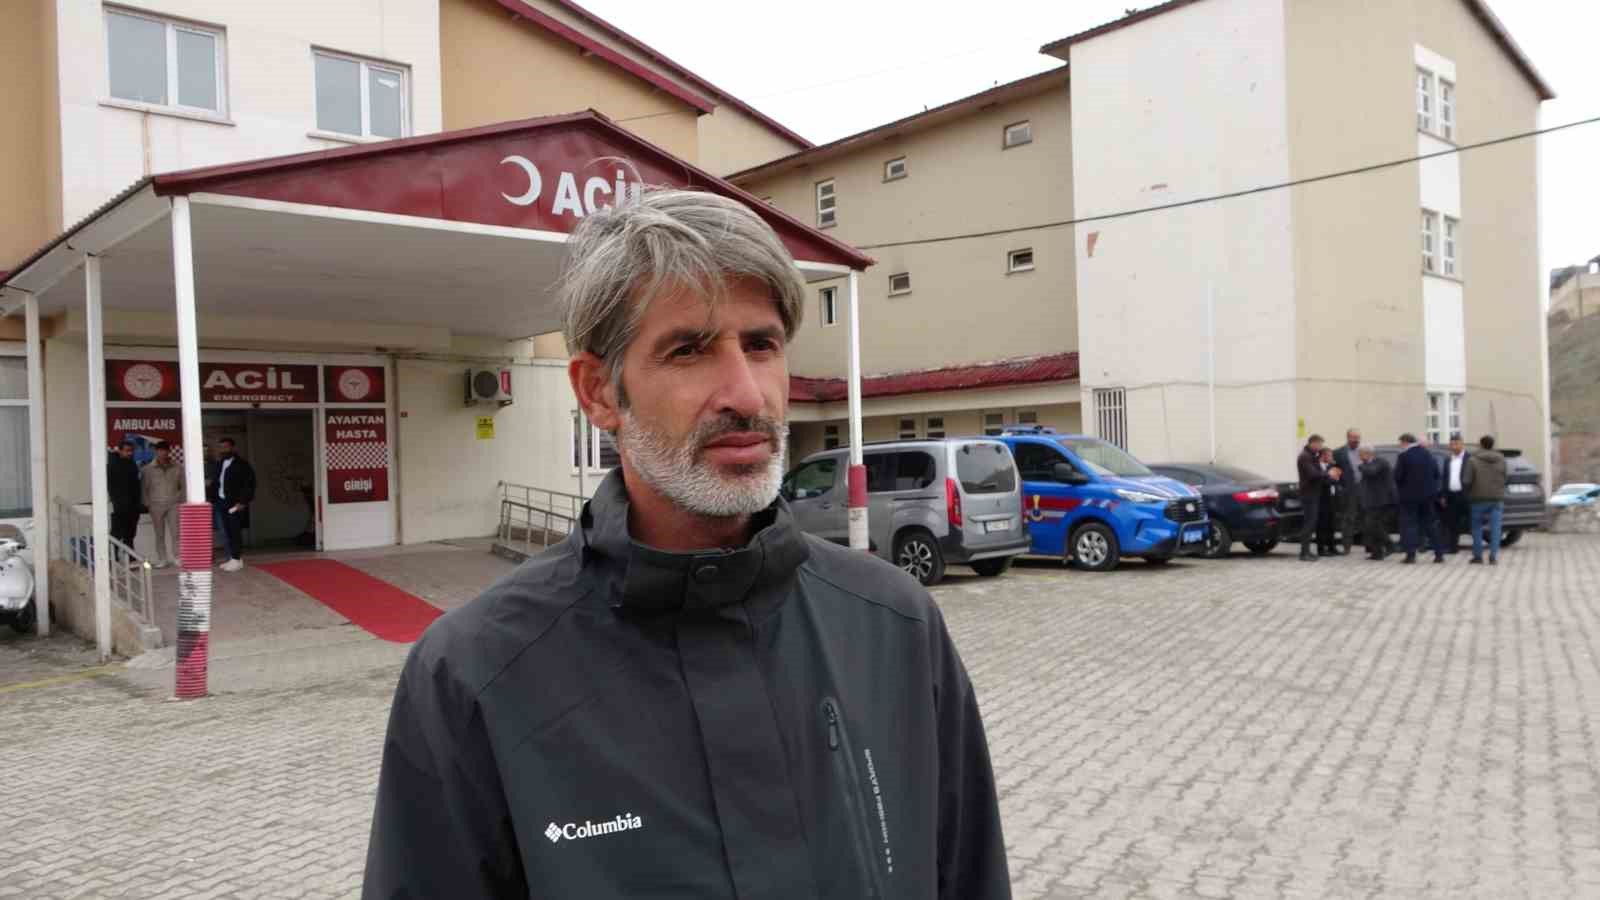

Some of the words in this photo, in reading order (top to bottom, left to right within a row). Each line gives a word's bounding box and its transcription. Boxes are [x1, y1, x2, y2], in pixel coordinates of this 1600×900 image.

[203, 367, 305, 389] ACİL
[113, 418, 176, 431] AMBULANS
[327, 415, 385, 425] AYAKTAN
[336, 430, 377, 439] HASTA
[562, 812, 643, 840] Columbia
